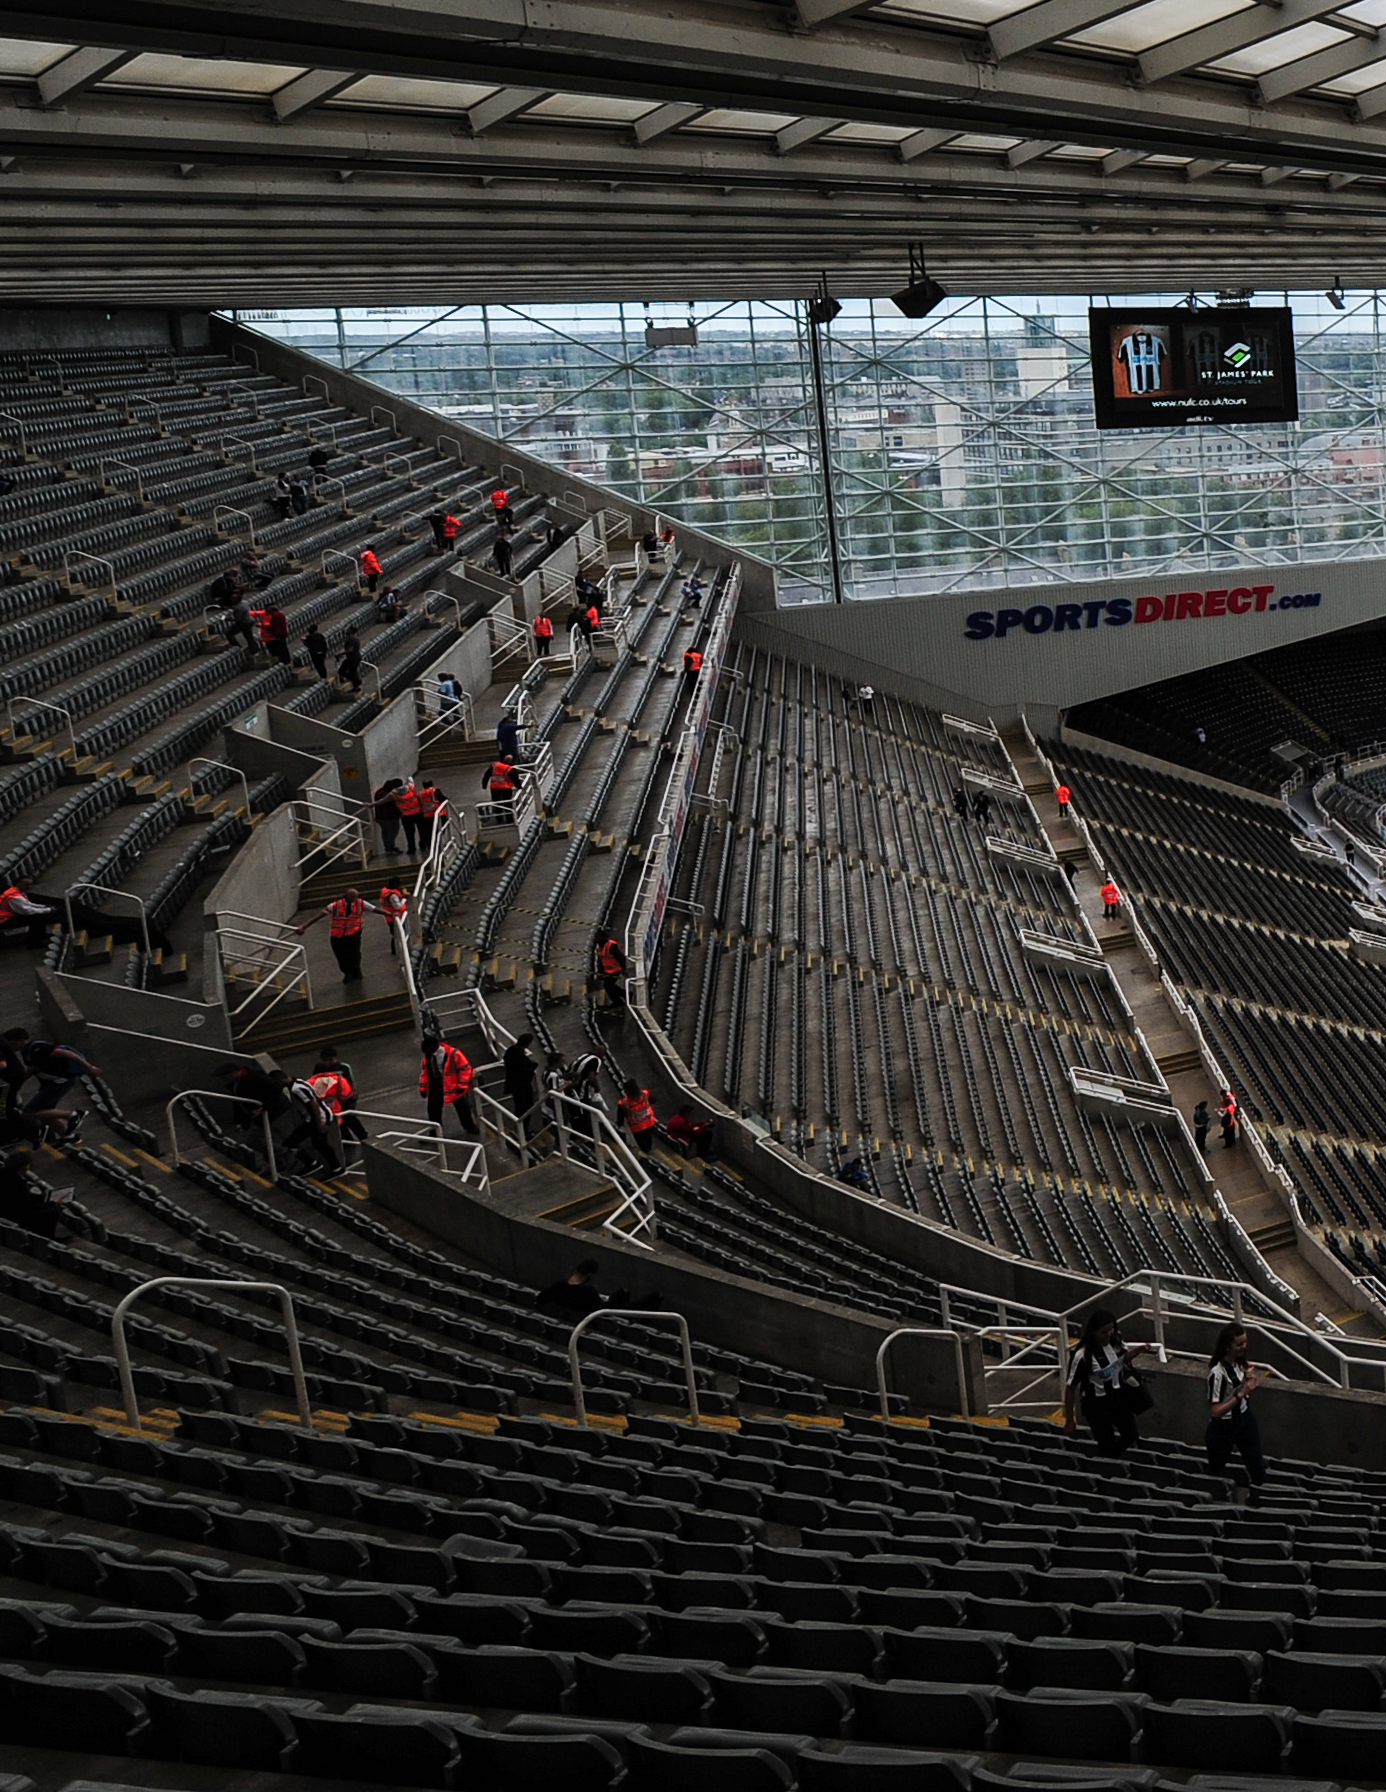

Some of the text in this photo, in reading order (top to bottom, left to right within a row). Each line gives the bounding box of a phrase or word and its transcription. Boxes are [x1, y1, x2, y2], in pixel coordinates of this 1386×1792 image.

[1217, 370, 1249, 380] JAMES'
[1251, 369, 1275, 377] PARK
[1152, 397, 1247, 408] www.nufc.co.uk/tours
